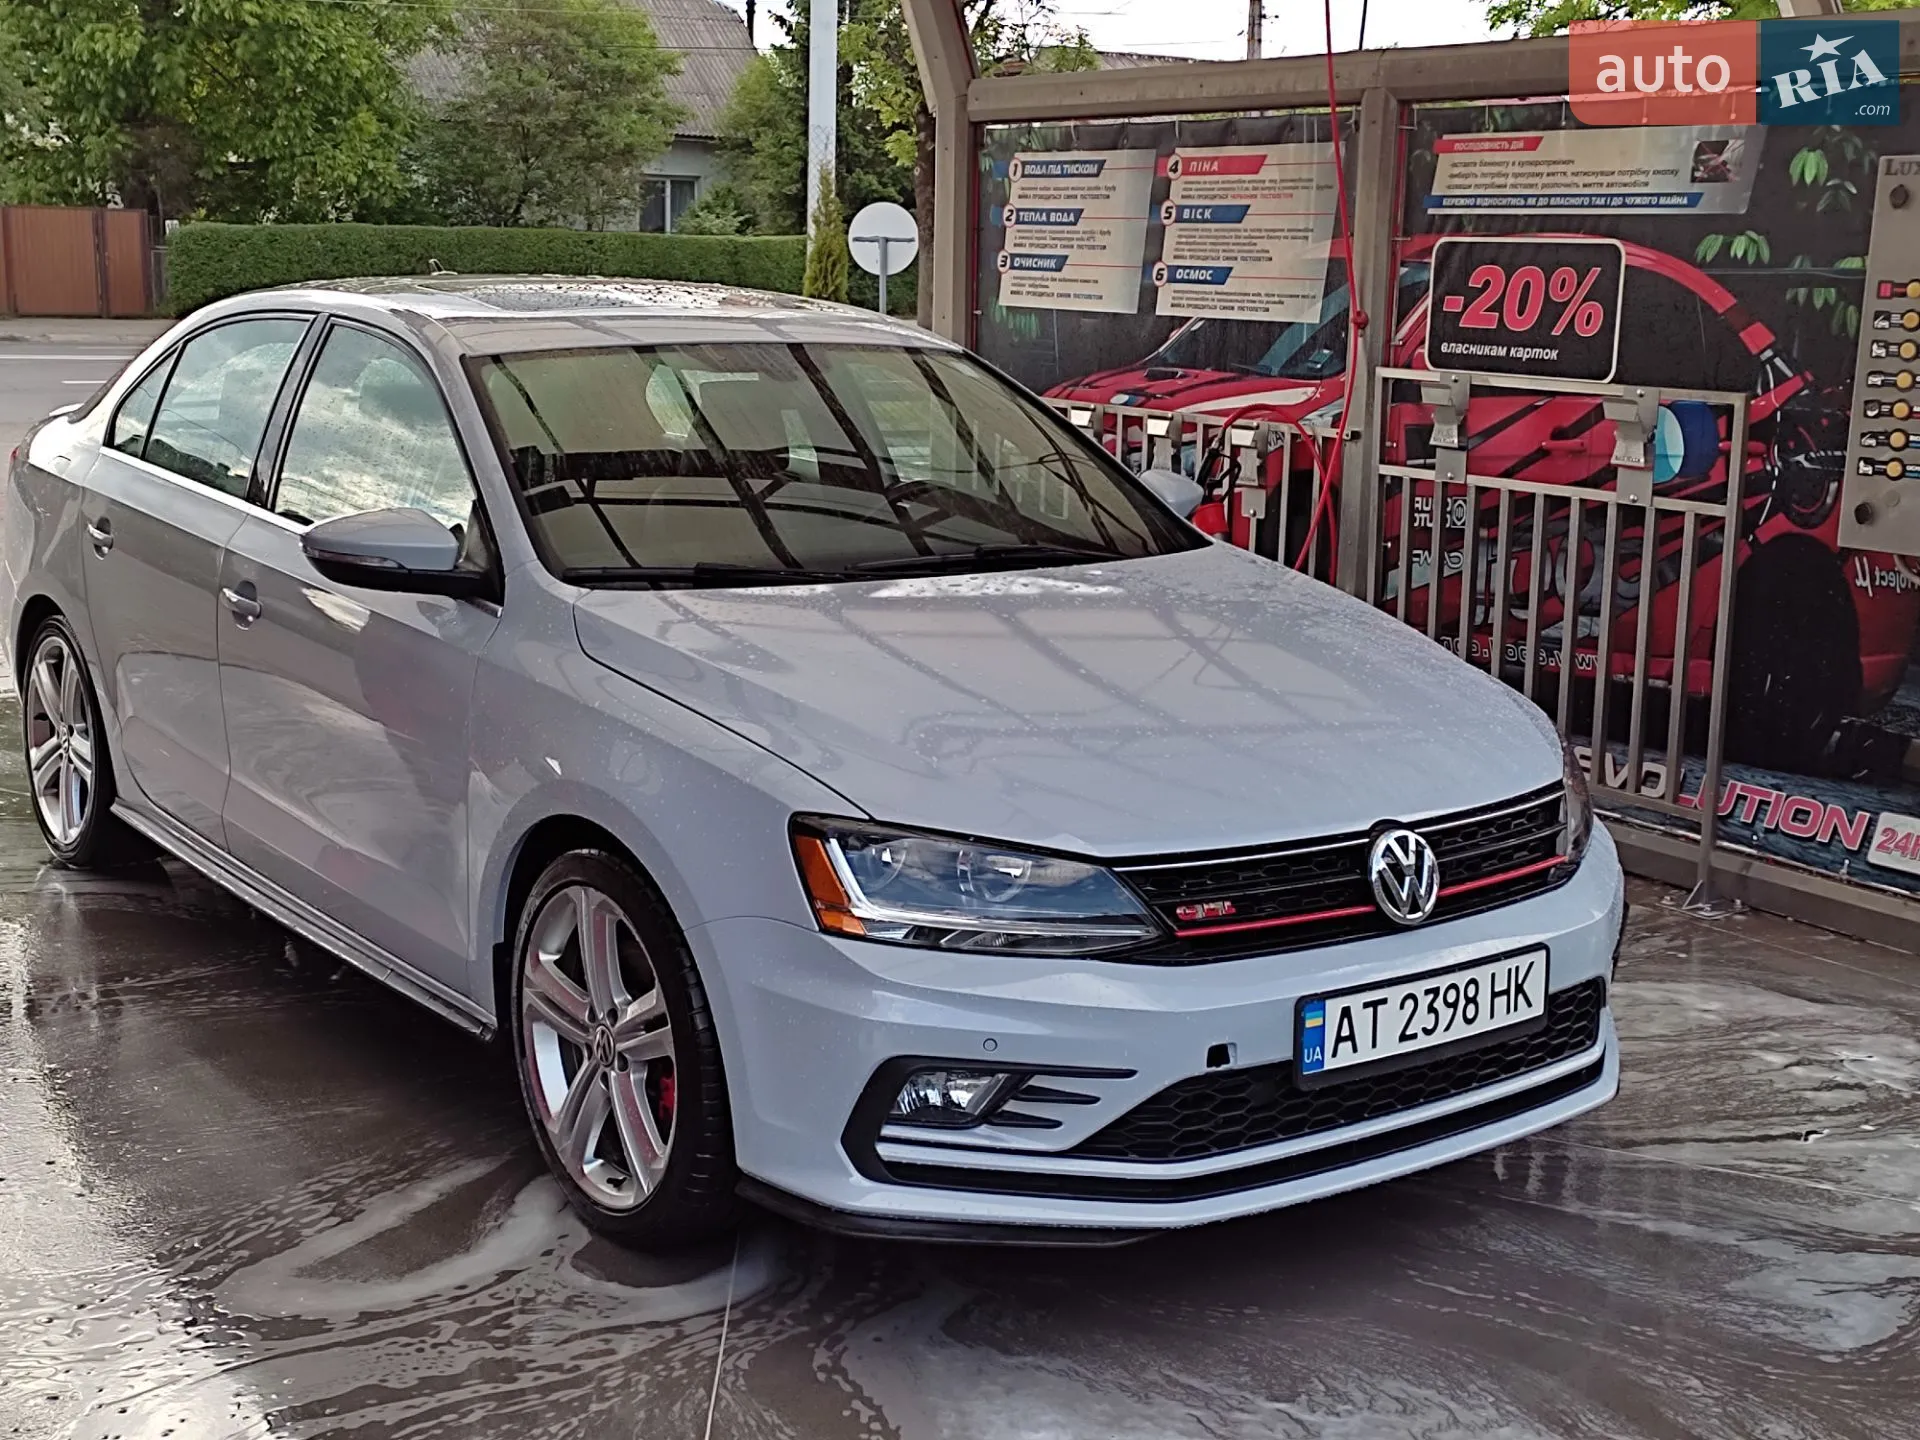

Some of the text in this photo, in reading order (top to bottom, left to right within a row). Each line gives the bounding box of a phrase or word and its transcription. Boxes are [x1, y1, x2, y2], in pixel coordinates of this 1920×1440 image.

[1013, 163, 1099, 177] 1 ВОДА ПІД ТИСКОМ
[1168, 160, 1219, 174] 4 ПІНА
[1511, 171, 1544, 180] програму
[1550, 196, 1589, 206] ВЛАСНОГО
[1591, 196, 1605, 205] ТАК
[1625, 196, 1657, 205] ЧУЖОГО
[1658, 194, 1688, 205] МАЙНА
[1005, 209, 1075, 222] 2 ТЕПЛА ВОДА
[1163, 206, 1212, 220] 5 ВІСК
[999, 255, 1056, 269] 3 ОЧИСНИК
[1155, 268, 1213, 281] 6 ОСМОС
[1443, 265, 1603, 337] -20%
[1441, 342, 1559, 362] власникам карток
[1331, 960, 1535, 1058] AT 2398 HK
[1304, 1046, 1322, 1063] UA
